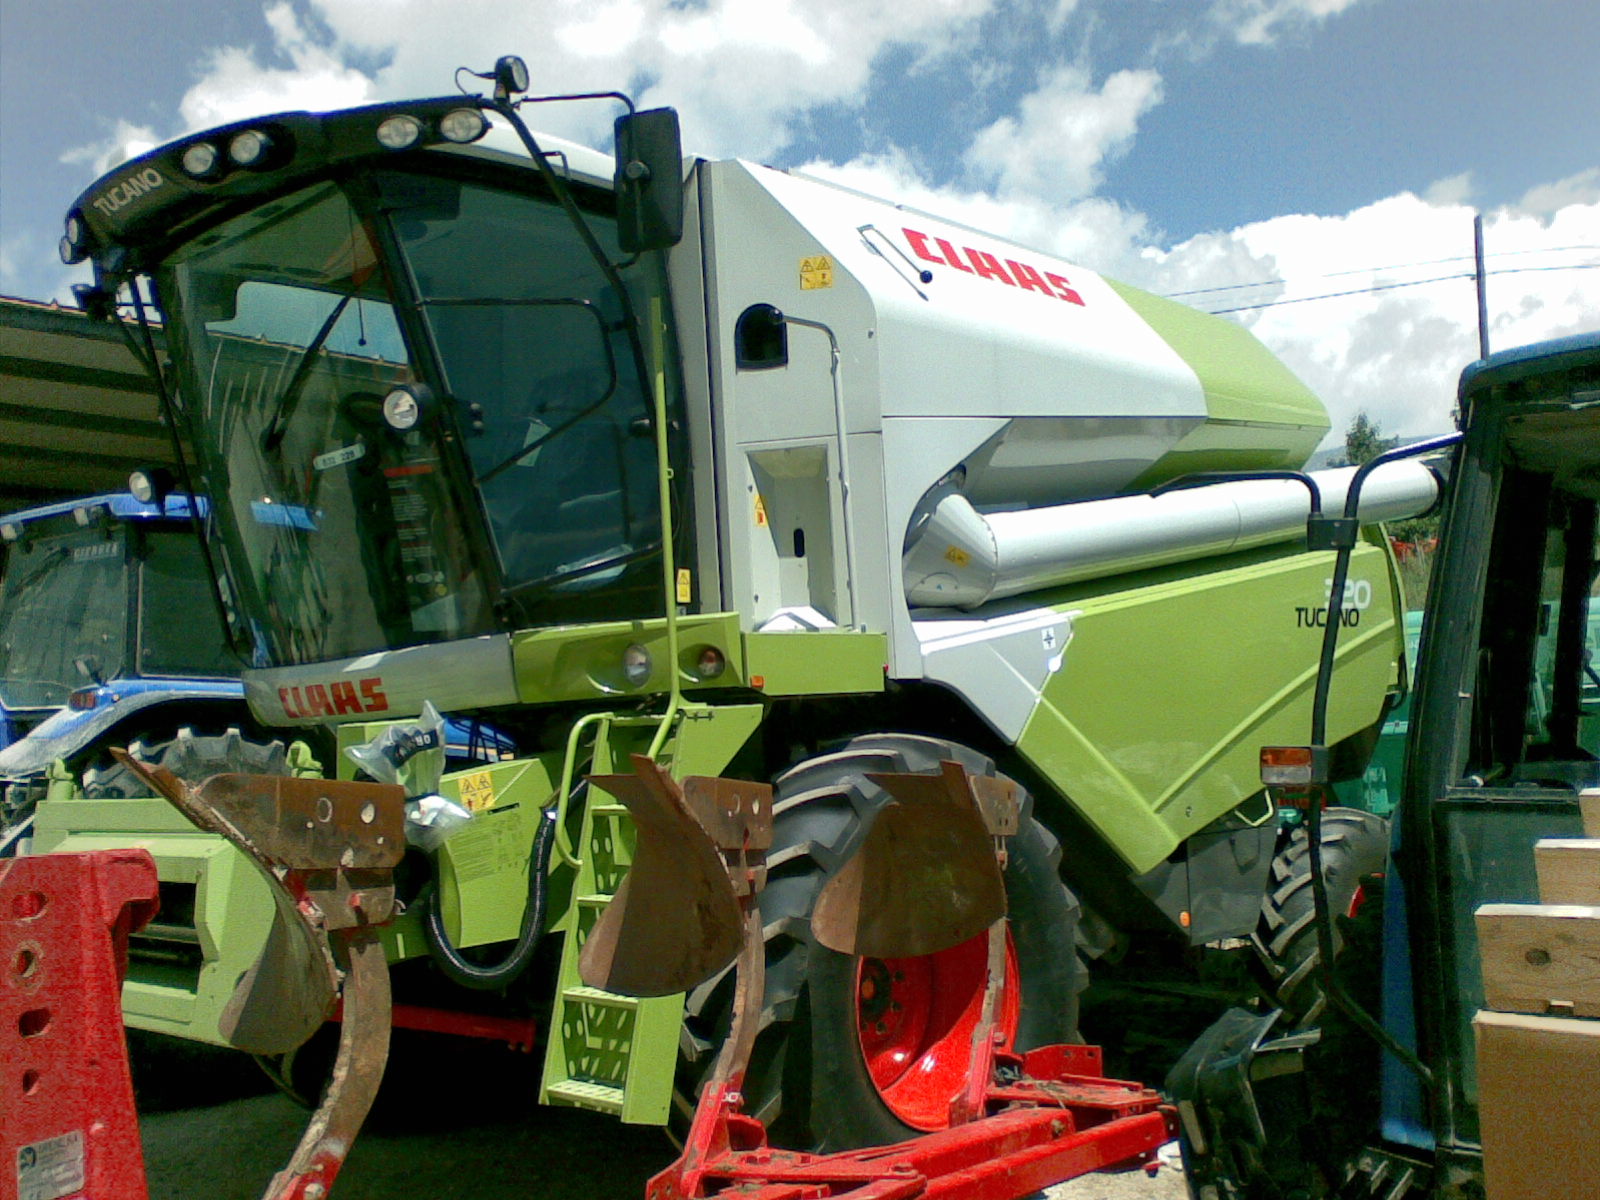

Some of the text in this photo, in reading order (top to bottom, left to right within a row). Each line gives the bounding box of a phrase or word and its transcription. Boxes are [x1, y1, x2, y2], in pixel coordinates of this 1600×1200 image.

[92, 168, 164, 217] TUCANO
[901, 227, 1086, 307] CLAAS
[1296, 607, 1360, 627] TUCNO
[279, 678, 389, 719] CLAAS
